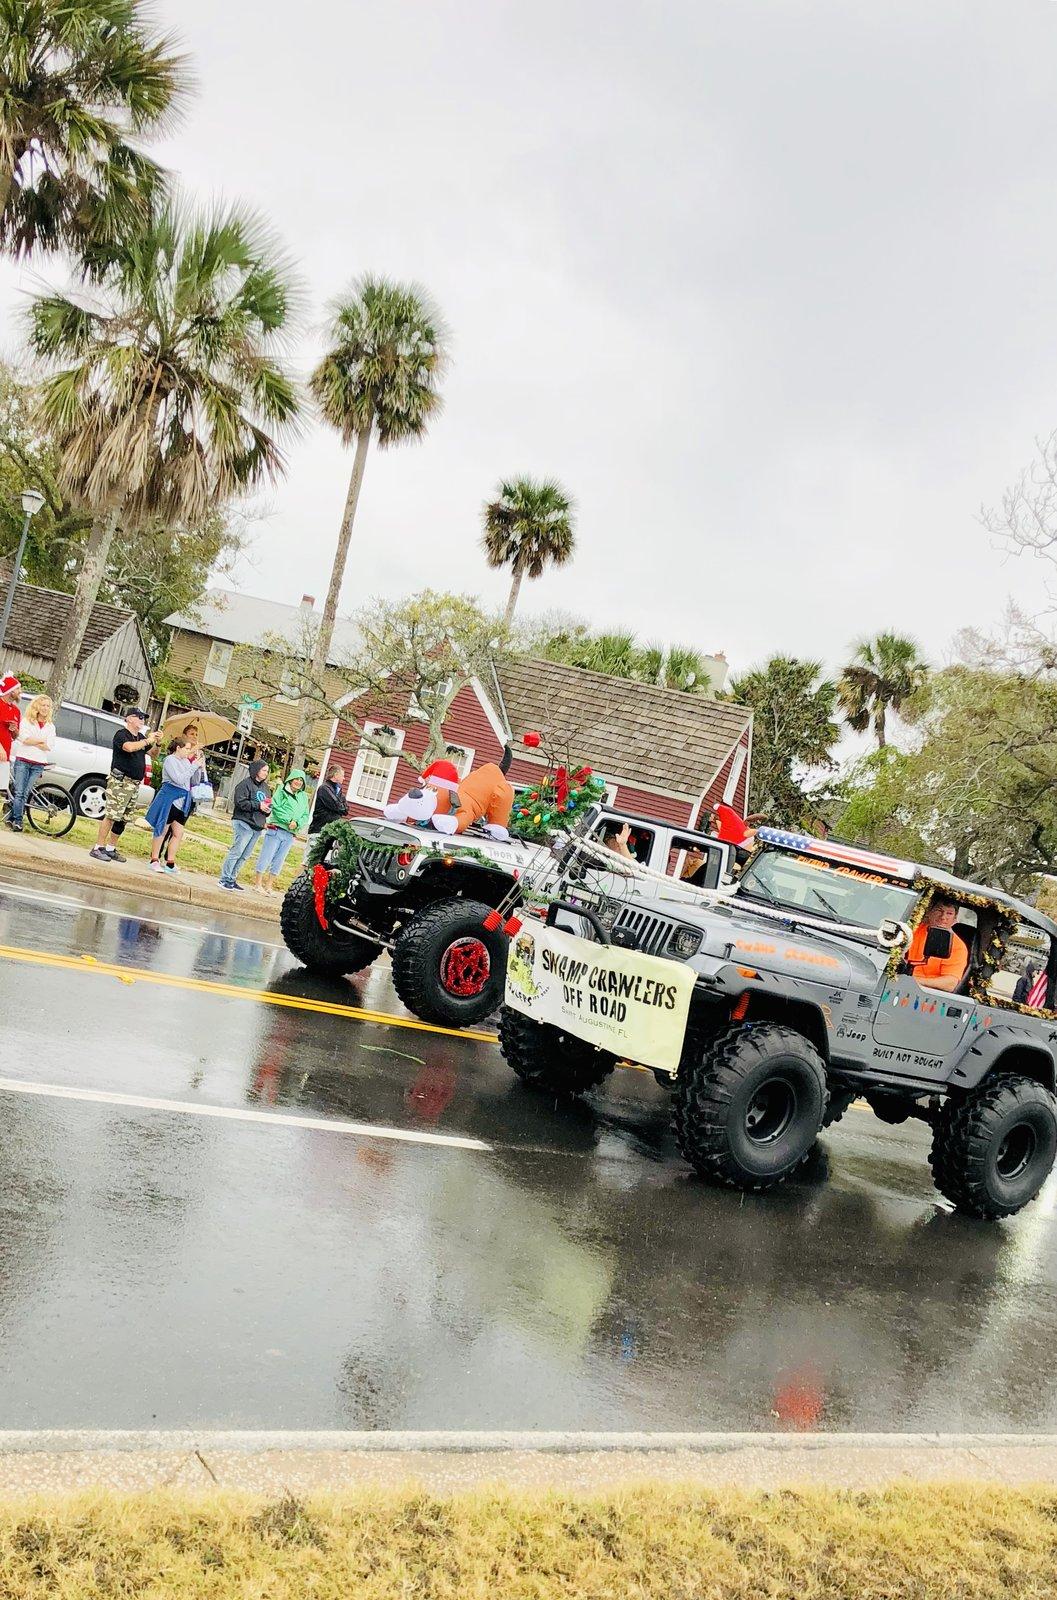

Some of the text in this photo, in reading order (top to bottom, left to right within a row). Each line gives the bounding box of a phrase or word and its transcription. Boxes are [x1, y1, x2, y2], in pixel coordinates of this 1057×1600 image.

[542, 949, 677, 1009] SWAMP CRAWLERS
[563, 985, 583, 1009] OFF
[589, 994, 627, 1022] ROAD
[847, 1029, 867, 1042] Jeep
[873, 1047, 944, 1069] BUILT NOT BOUGHT
